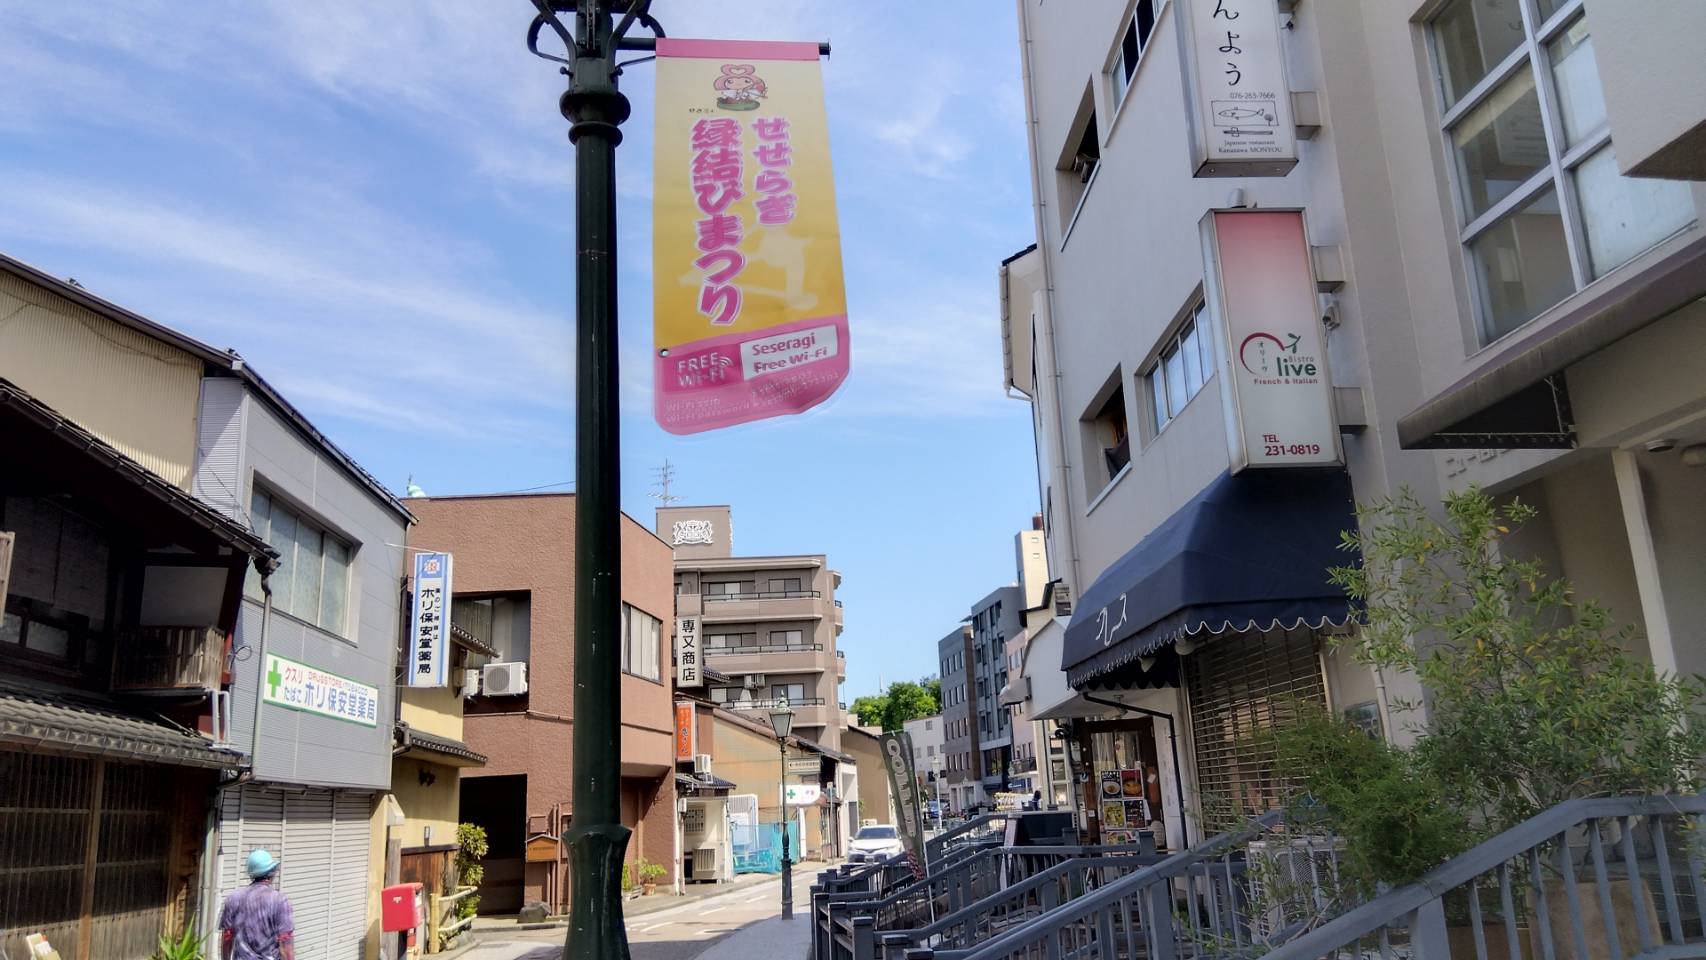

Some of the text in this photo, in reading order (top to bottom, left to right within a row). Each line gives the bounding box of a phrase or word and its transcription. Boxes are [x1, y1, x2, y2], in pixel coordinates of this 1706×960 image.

[751, 117, 798, 225] せせらぎ
[691, 117, 745, 325] 縁結びまつり
[752, 332, 816, 356] Seseragi
[678, 352, 719, 373] FREE
[753, 347, 827, 374] Free Wi-Fi
[1263, 435, 1280, 443] TEL
[1264, 444, 1320, 456] 231-0819
[417, 588, 435, 675] ホリ保安堂薬局
[682, 620, 695, 682] 専又商店
[284, 666, 303, 685] クスリ
[284, 686, 303, 704] たばこ
[304, 682, 376, 721] ホリ保安堂薬局
